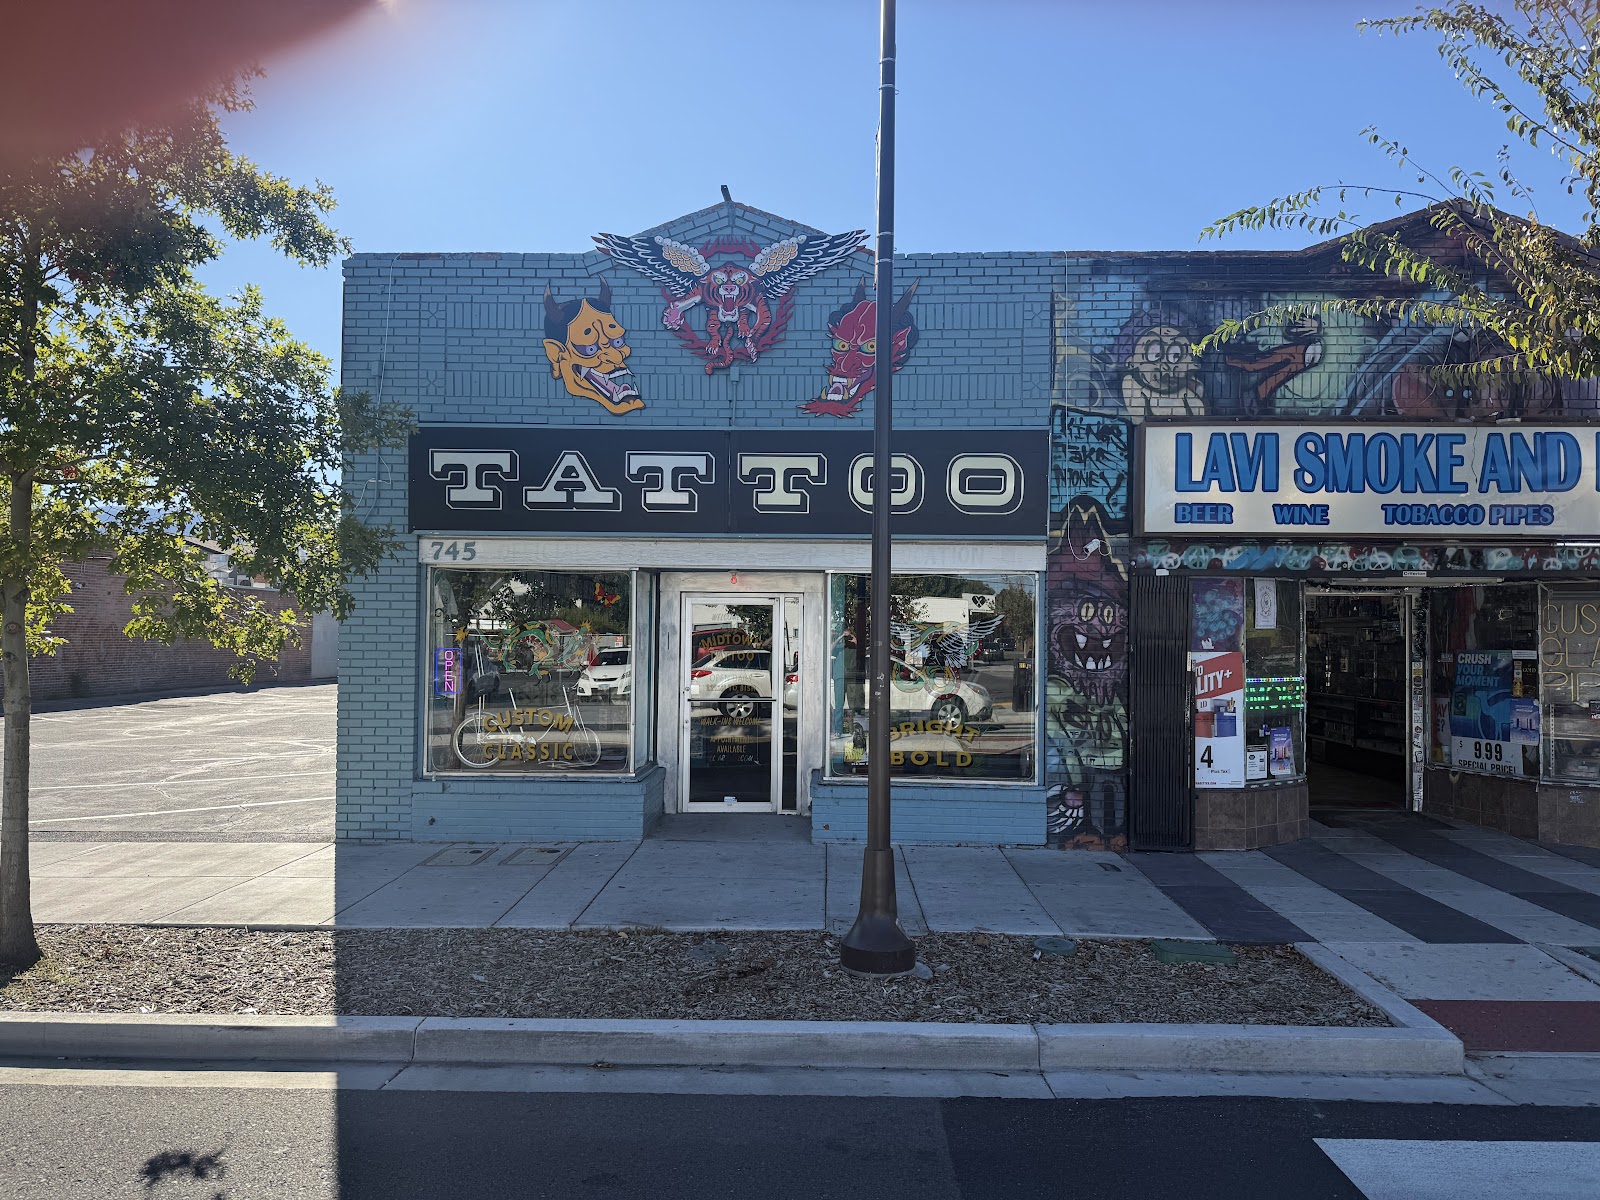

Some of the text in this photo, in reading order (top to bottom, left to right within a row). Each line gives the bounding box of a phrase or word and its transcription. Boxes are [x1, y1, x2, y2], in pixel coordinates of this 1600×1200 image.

[1174, 432, 1280, 493] LAVI
[1294, 431, 1468, 494] SMOKE
[1478, 432, 1582, 493] AND
[429, 449, 1025, 516] TATTOO
[1174, 503, 1555, 526] BEER WINE TOBACCO PIPES
[431, 541, 478, 561] 745
[1457, 653, 1491, 665] CRUSH
[1457, 664, 1485, 675] YOUR
[444, 650, 455, 692] OPEN
[1456, 675, 1500, 687] MOMENT
[1195, 669, 1233, 696] LITY+
[483, 708, 574, 734] CUSTOM
[890, 719, 981, 743] BRIGHT
[482, 742, 573, 760] CLASSIC
[890, 751, 973, 768] BOLD
[1200, 745, 1214, 768] 4
[1474, 741, 1503, 761] 9.99
[1458, 759, 1487, 771] SPECIAL
